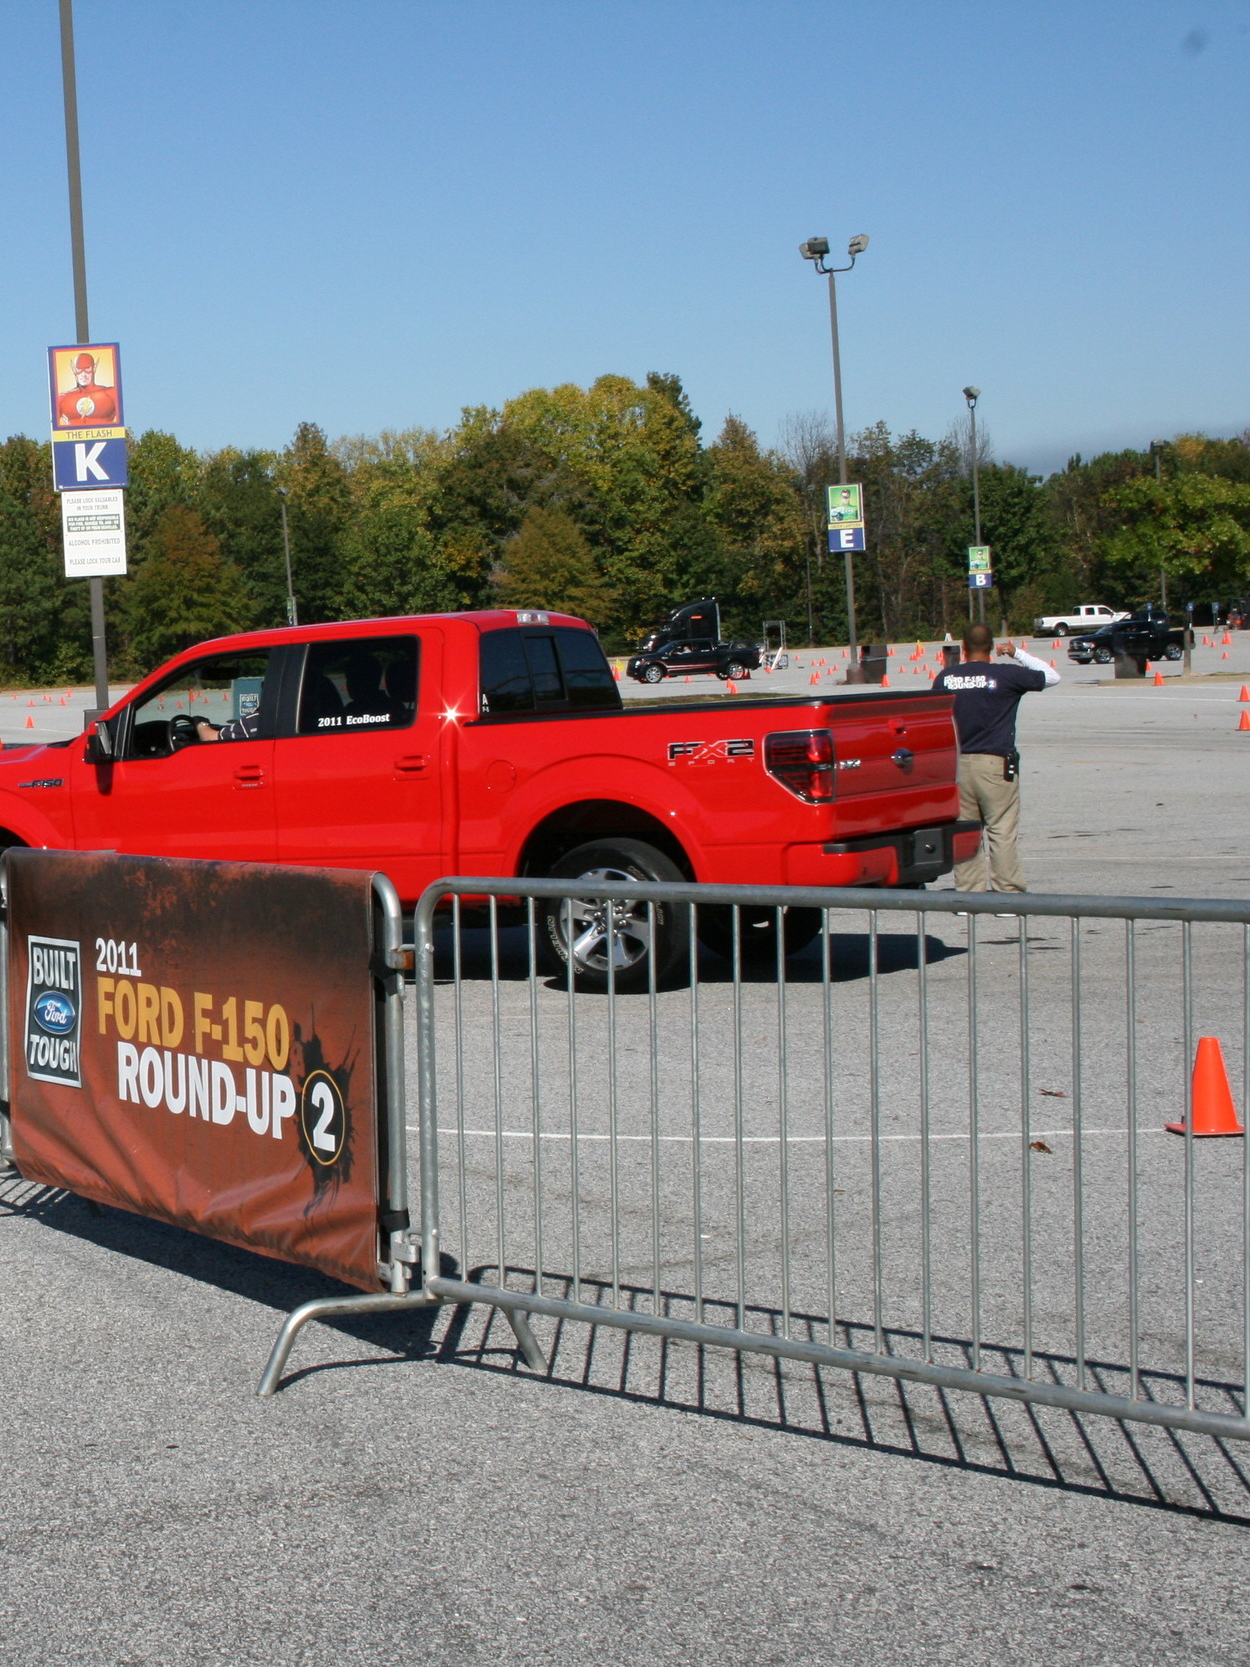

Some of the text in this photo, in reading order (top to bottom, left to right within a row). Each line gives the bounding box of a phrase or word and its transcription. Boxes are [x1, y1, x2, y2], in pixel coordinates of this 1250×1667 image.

[66, 429, 113, 440] THE FLASH
[75, 442, 110, 481] K
[92, 538, 120, 546] PROHIBITED
[840, 529, 854, 548] E
[975, 574, 986, 586] B
[318, 713, 390, 727] 2011 EcoBoost
[33, 947, 76, 990] BUILT
[96, 937, 142, 978] 2011
[44, 1000, 68, 1024] Ford
[98, 976, 290, 1072] FORD F-150
[30, 1034, 77, 1073] TOUGH
[117, 1040, 337, 1152] ROUND-UP 2
